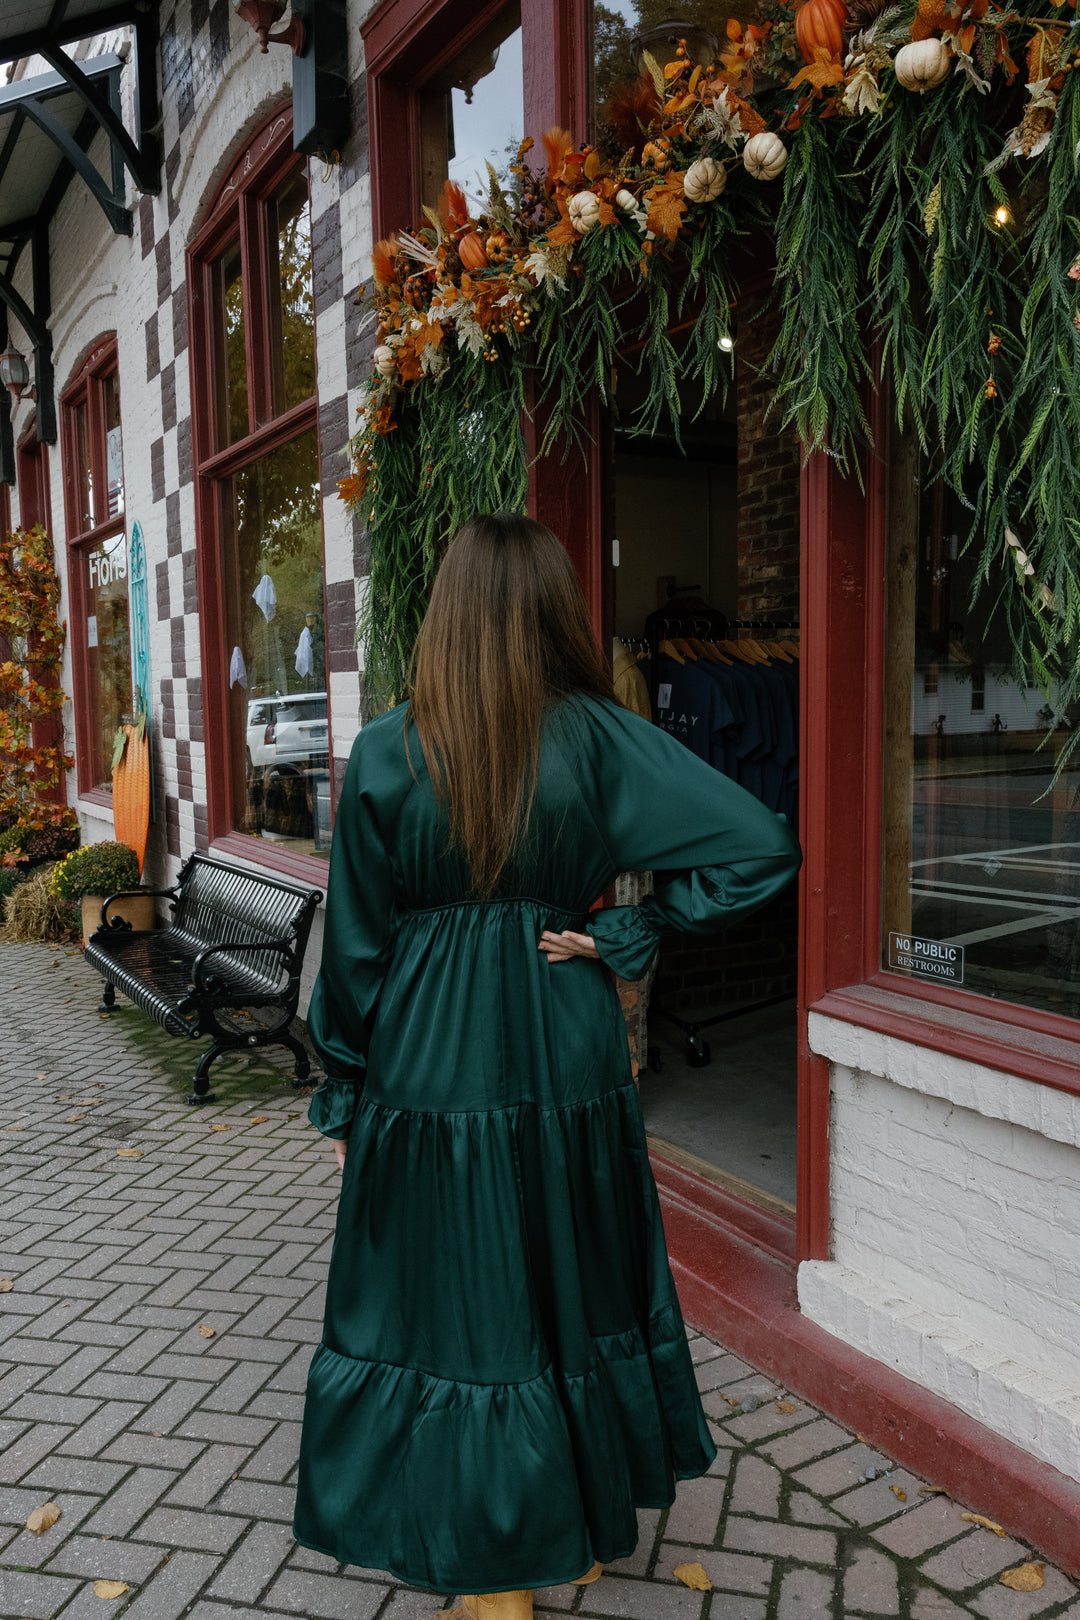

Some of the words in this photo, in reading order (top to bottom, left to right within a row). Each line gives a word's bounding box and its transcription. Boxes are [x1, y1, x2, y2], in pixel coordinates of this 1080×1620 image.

[896, 937, 911, 951] NO
[914, 941, 957, 961] PUBLIC
[897, 955, 955, 977] RESTROOMS
